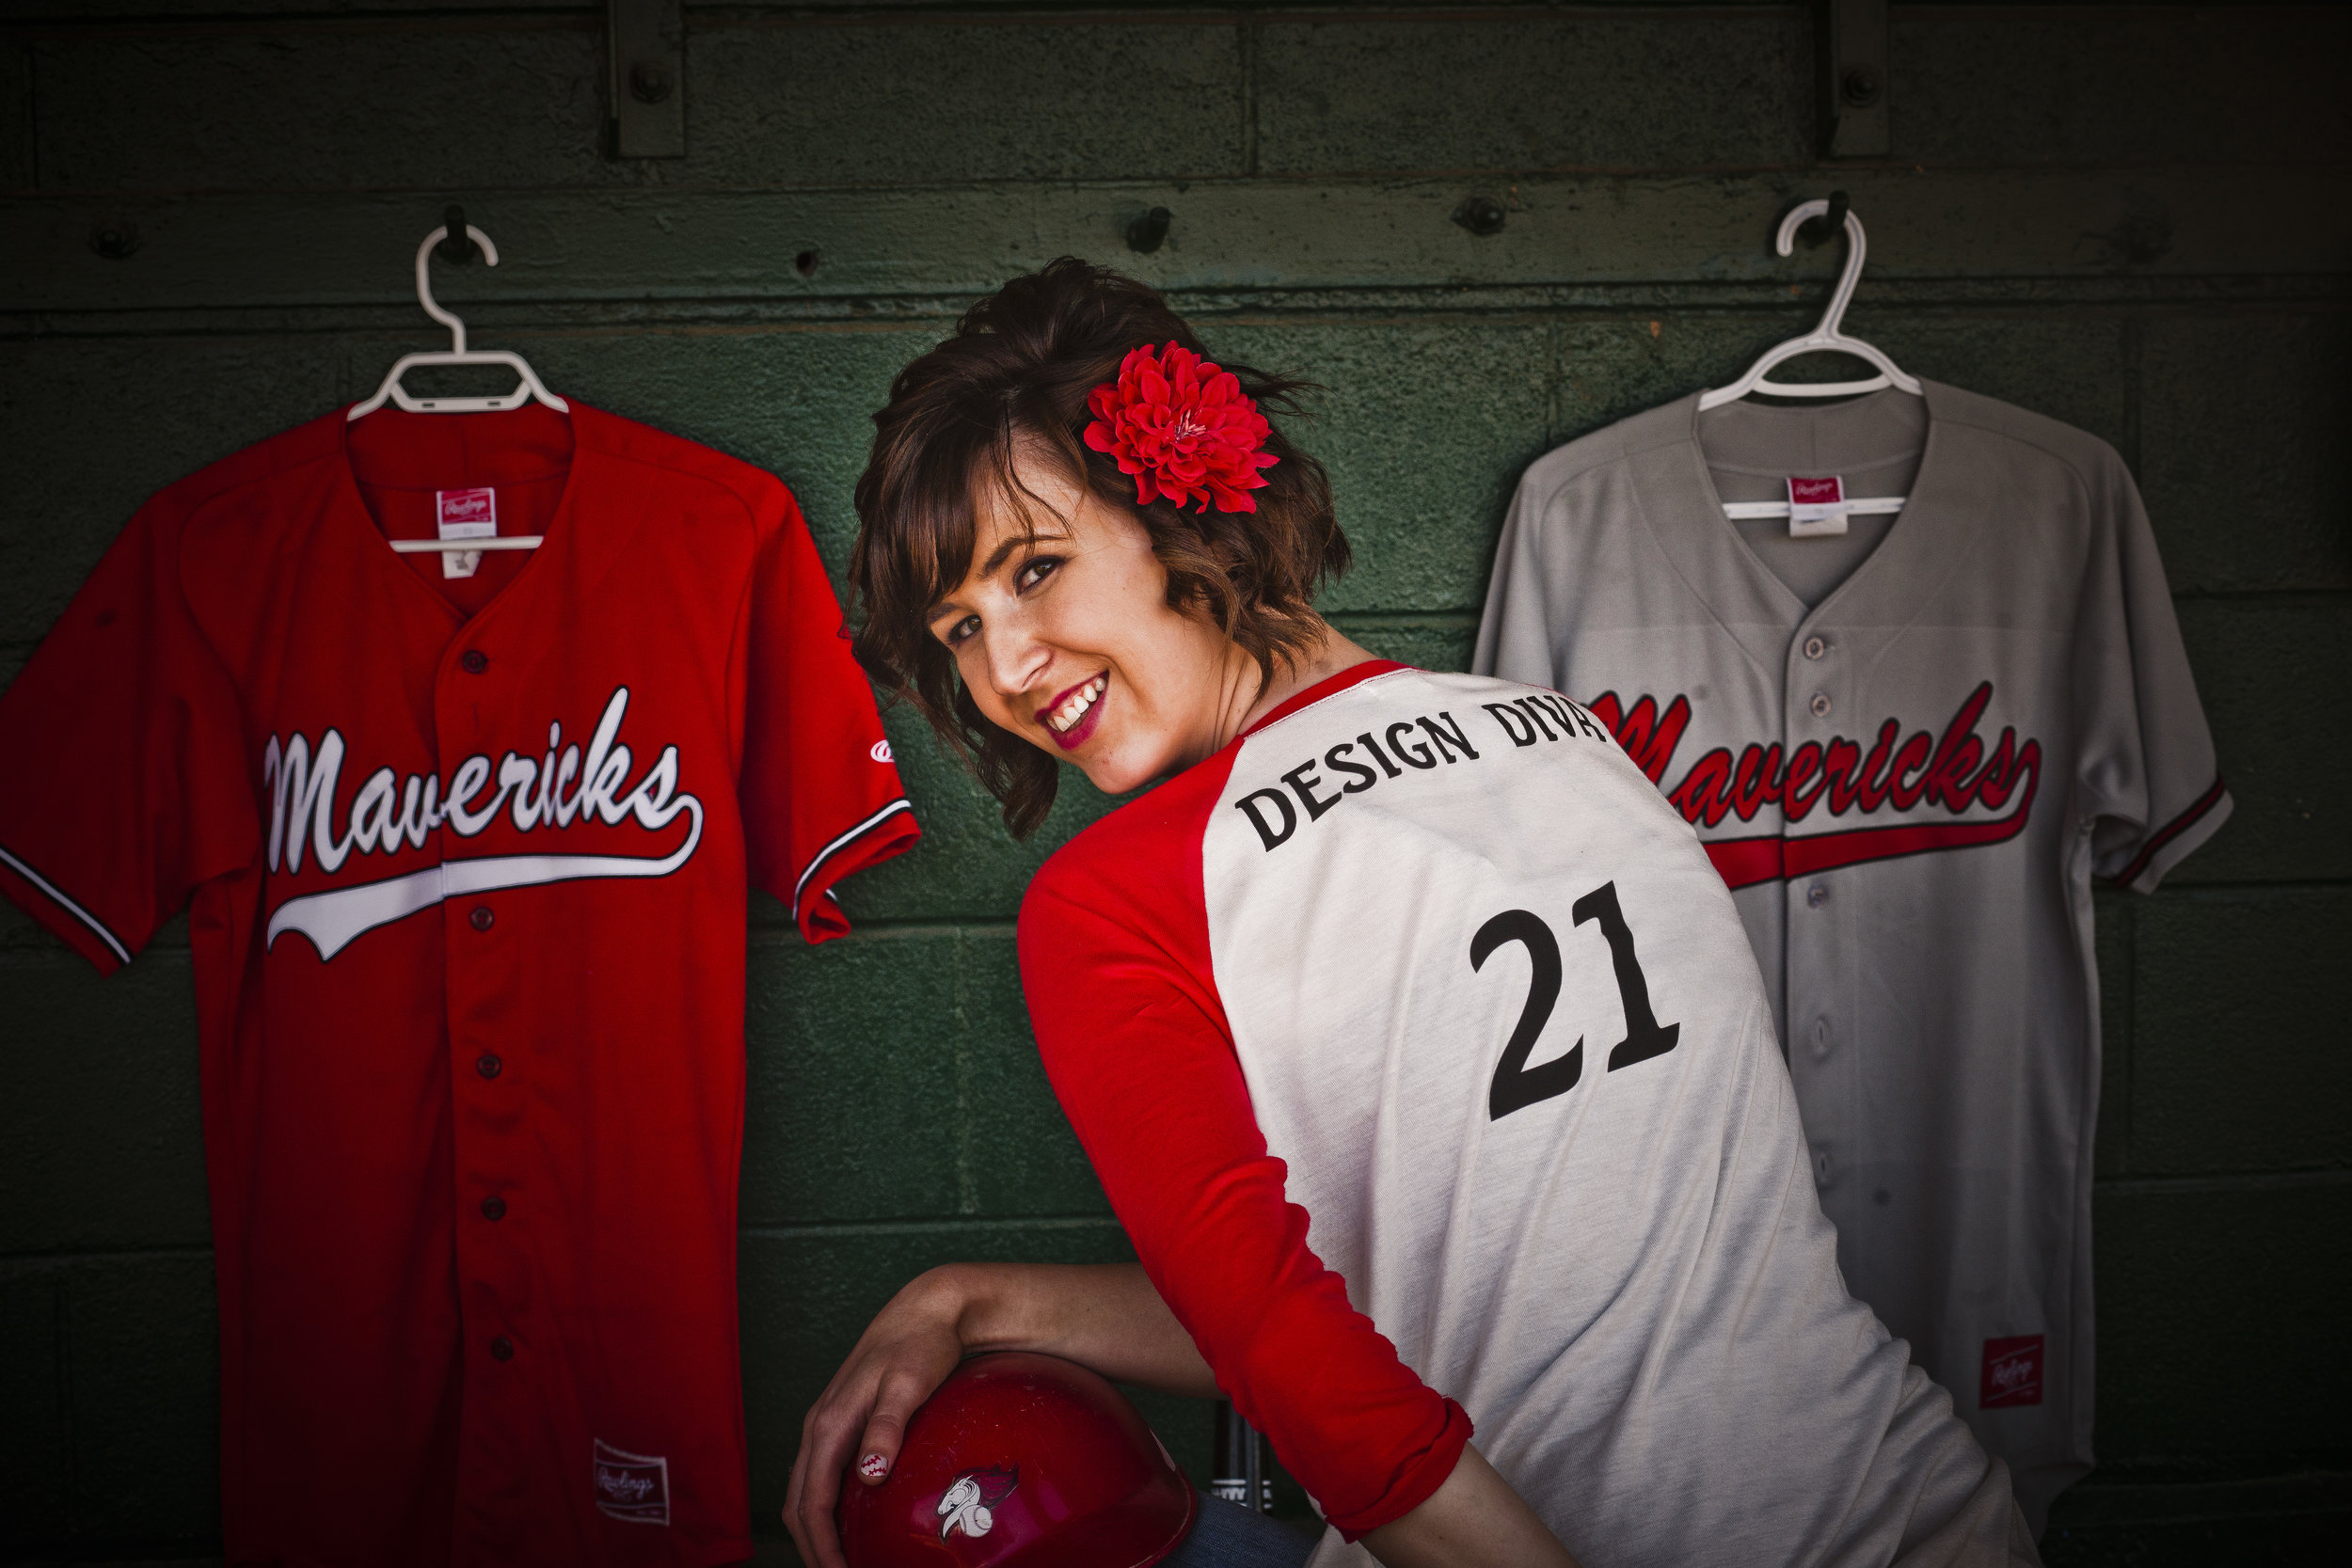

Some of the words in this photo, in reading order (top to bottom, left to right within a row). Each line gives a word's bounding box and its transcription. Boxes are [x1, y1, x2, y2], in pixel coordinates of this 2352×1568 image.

[263, 685, 703, 875] Mavericks
[1234, 711, 1480, 853] DESIGN
[1482, 694, 1607, 747] DIVA
[1470, 879, 1680, 1121] 21
